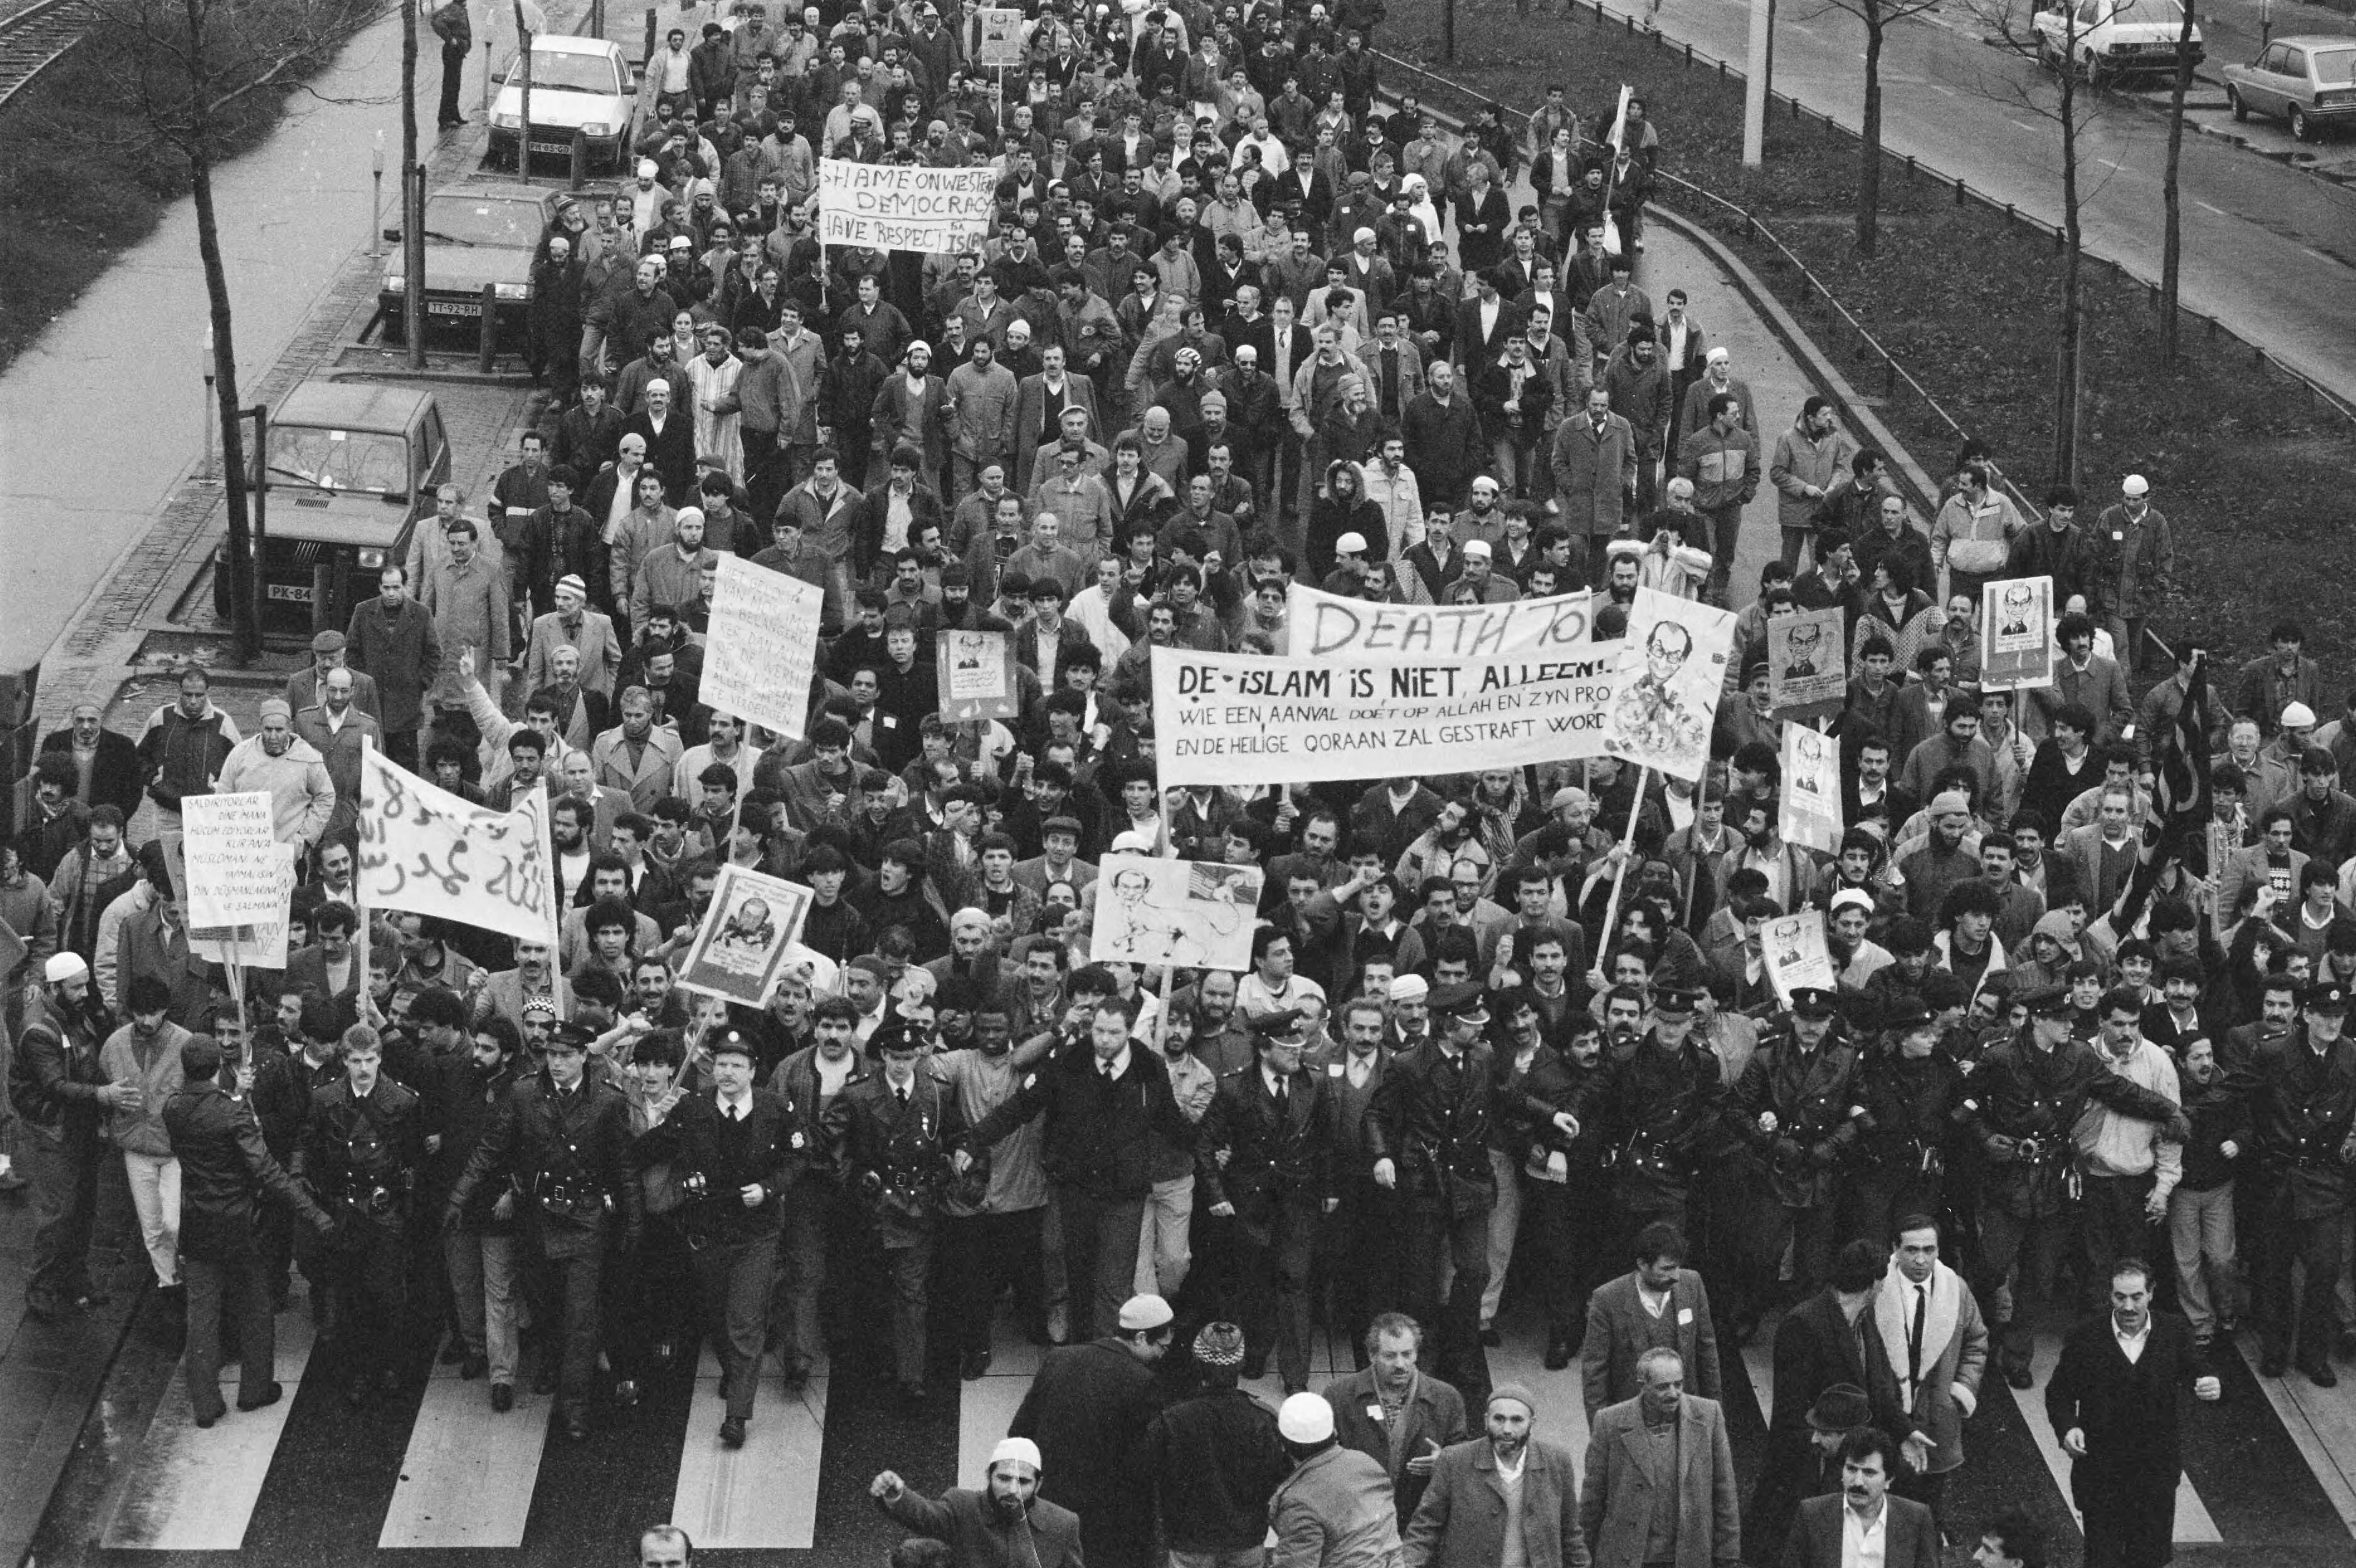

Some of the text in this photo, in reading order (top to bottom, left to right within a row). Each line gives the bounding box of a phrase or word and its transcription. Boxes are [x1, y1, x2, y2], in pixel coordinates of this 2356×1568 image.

[916, 173, 940, 191] ON
[856, 192, 995, 218] DEMOCRACY
[874, 221, 946, 252] RESPECT
[945, 232, 986, 253] ISLA
[433, 303, 478, 314] TT-92-PH
[1311, 595, 1589, 656] DEATH TO
[1178, 665, 1219, 695] DE
[1179, 707, 1217, 725] WIE
[1225, 706, 1261, 724] EEN
[1269, 706, 1339, 723] AANVAL
[1348, 708, 1399, 720] DOET
[1404, 706, 1429, 719] OP
[1436, 698, 1492, 718] ALLAH
[1498, 693, 1521, 711] EN
[1575, 686, 1612, 704] PRO
[1176, 739, 1198, 755] EN
[1203, 738, 1225, 755] DE
[1393, 728, 1433, 747] ZAL
[1439, 720, 1536, 743] GESTRAFT
[1546, 712, 1607, 733] WORD
